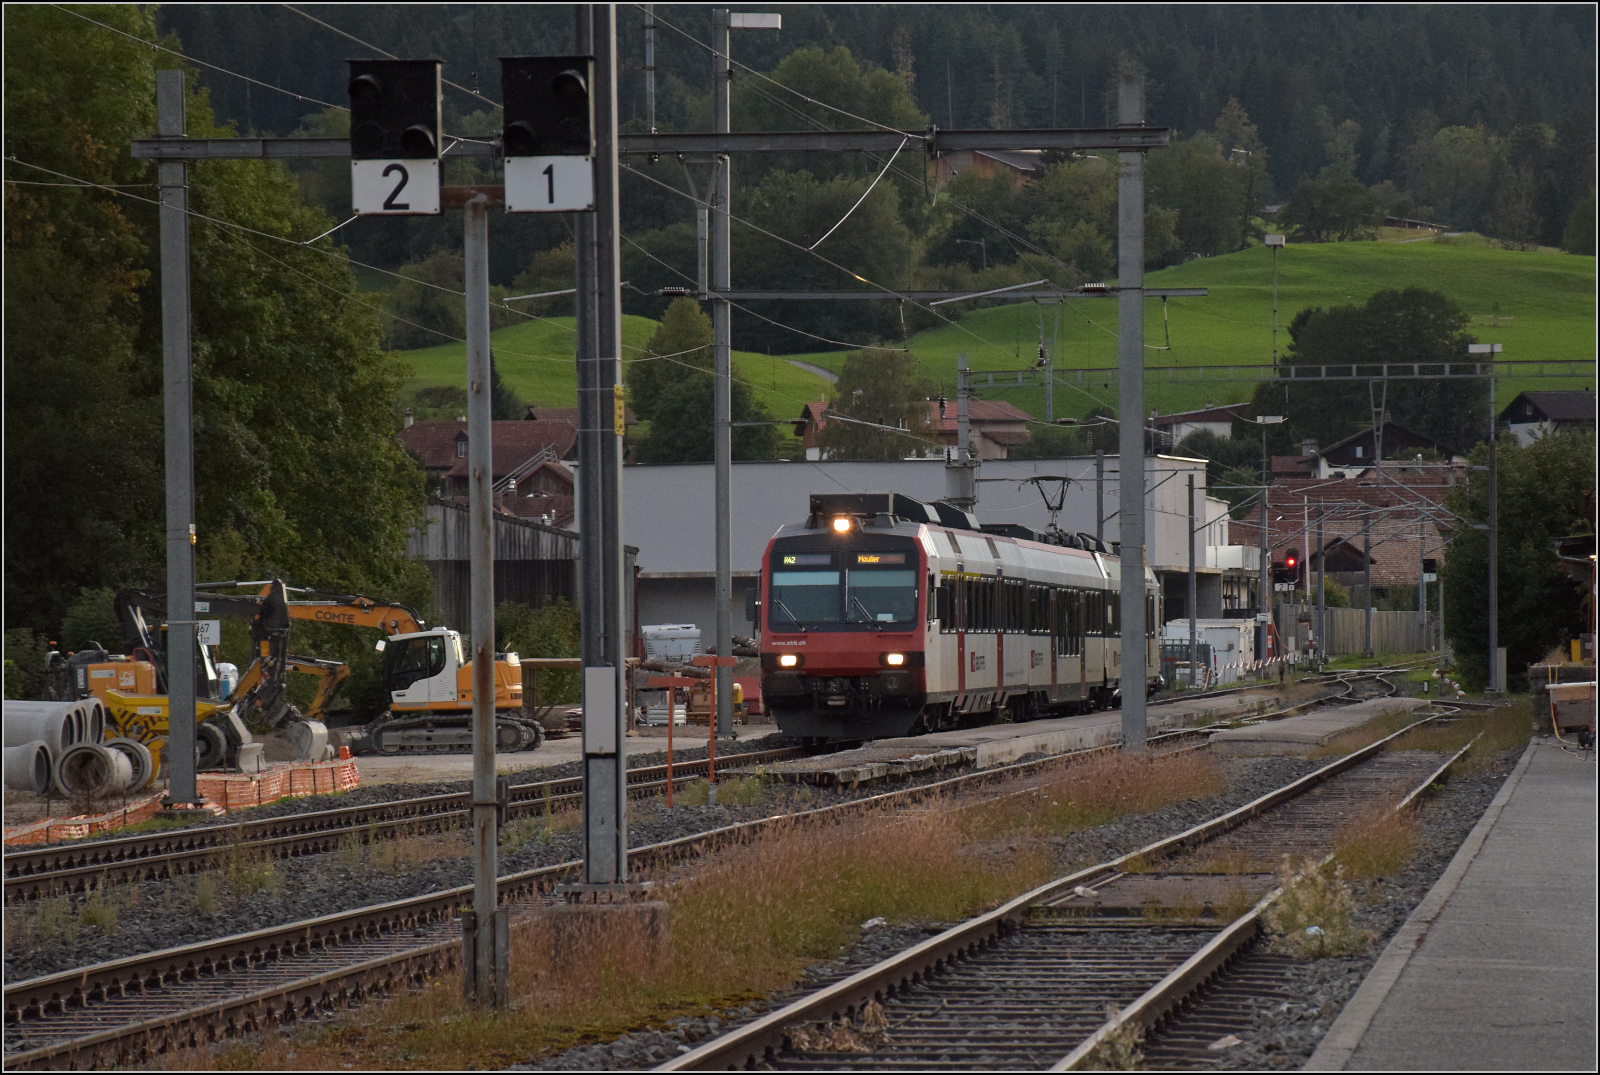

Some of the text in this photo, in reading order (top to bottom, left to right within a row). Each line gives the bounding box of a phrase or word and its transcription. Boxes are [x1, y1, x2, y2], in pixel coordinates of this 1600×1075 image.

[382, 163, 410, 211] 2
[542, 163, 555, 204] 1
[783, 556, 796, 564] R42
[1279, 583, 1284, 591] 2
[315, 610, 355, 624] COMTE
[200, 623, 210, 633] 67
